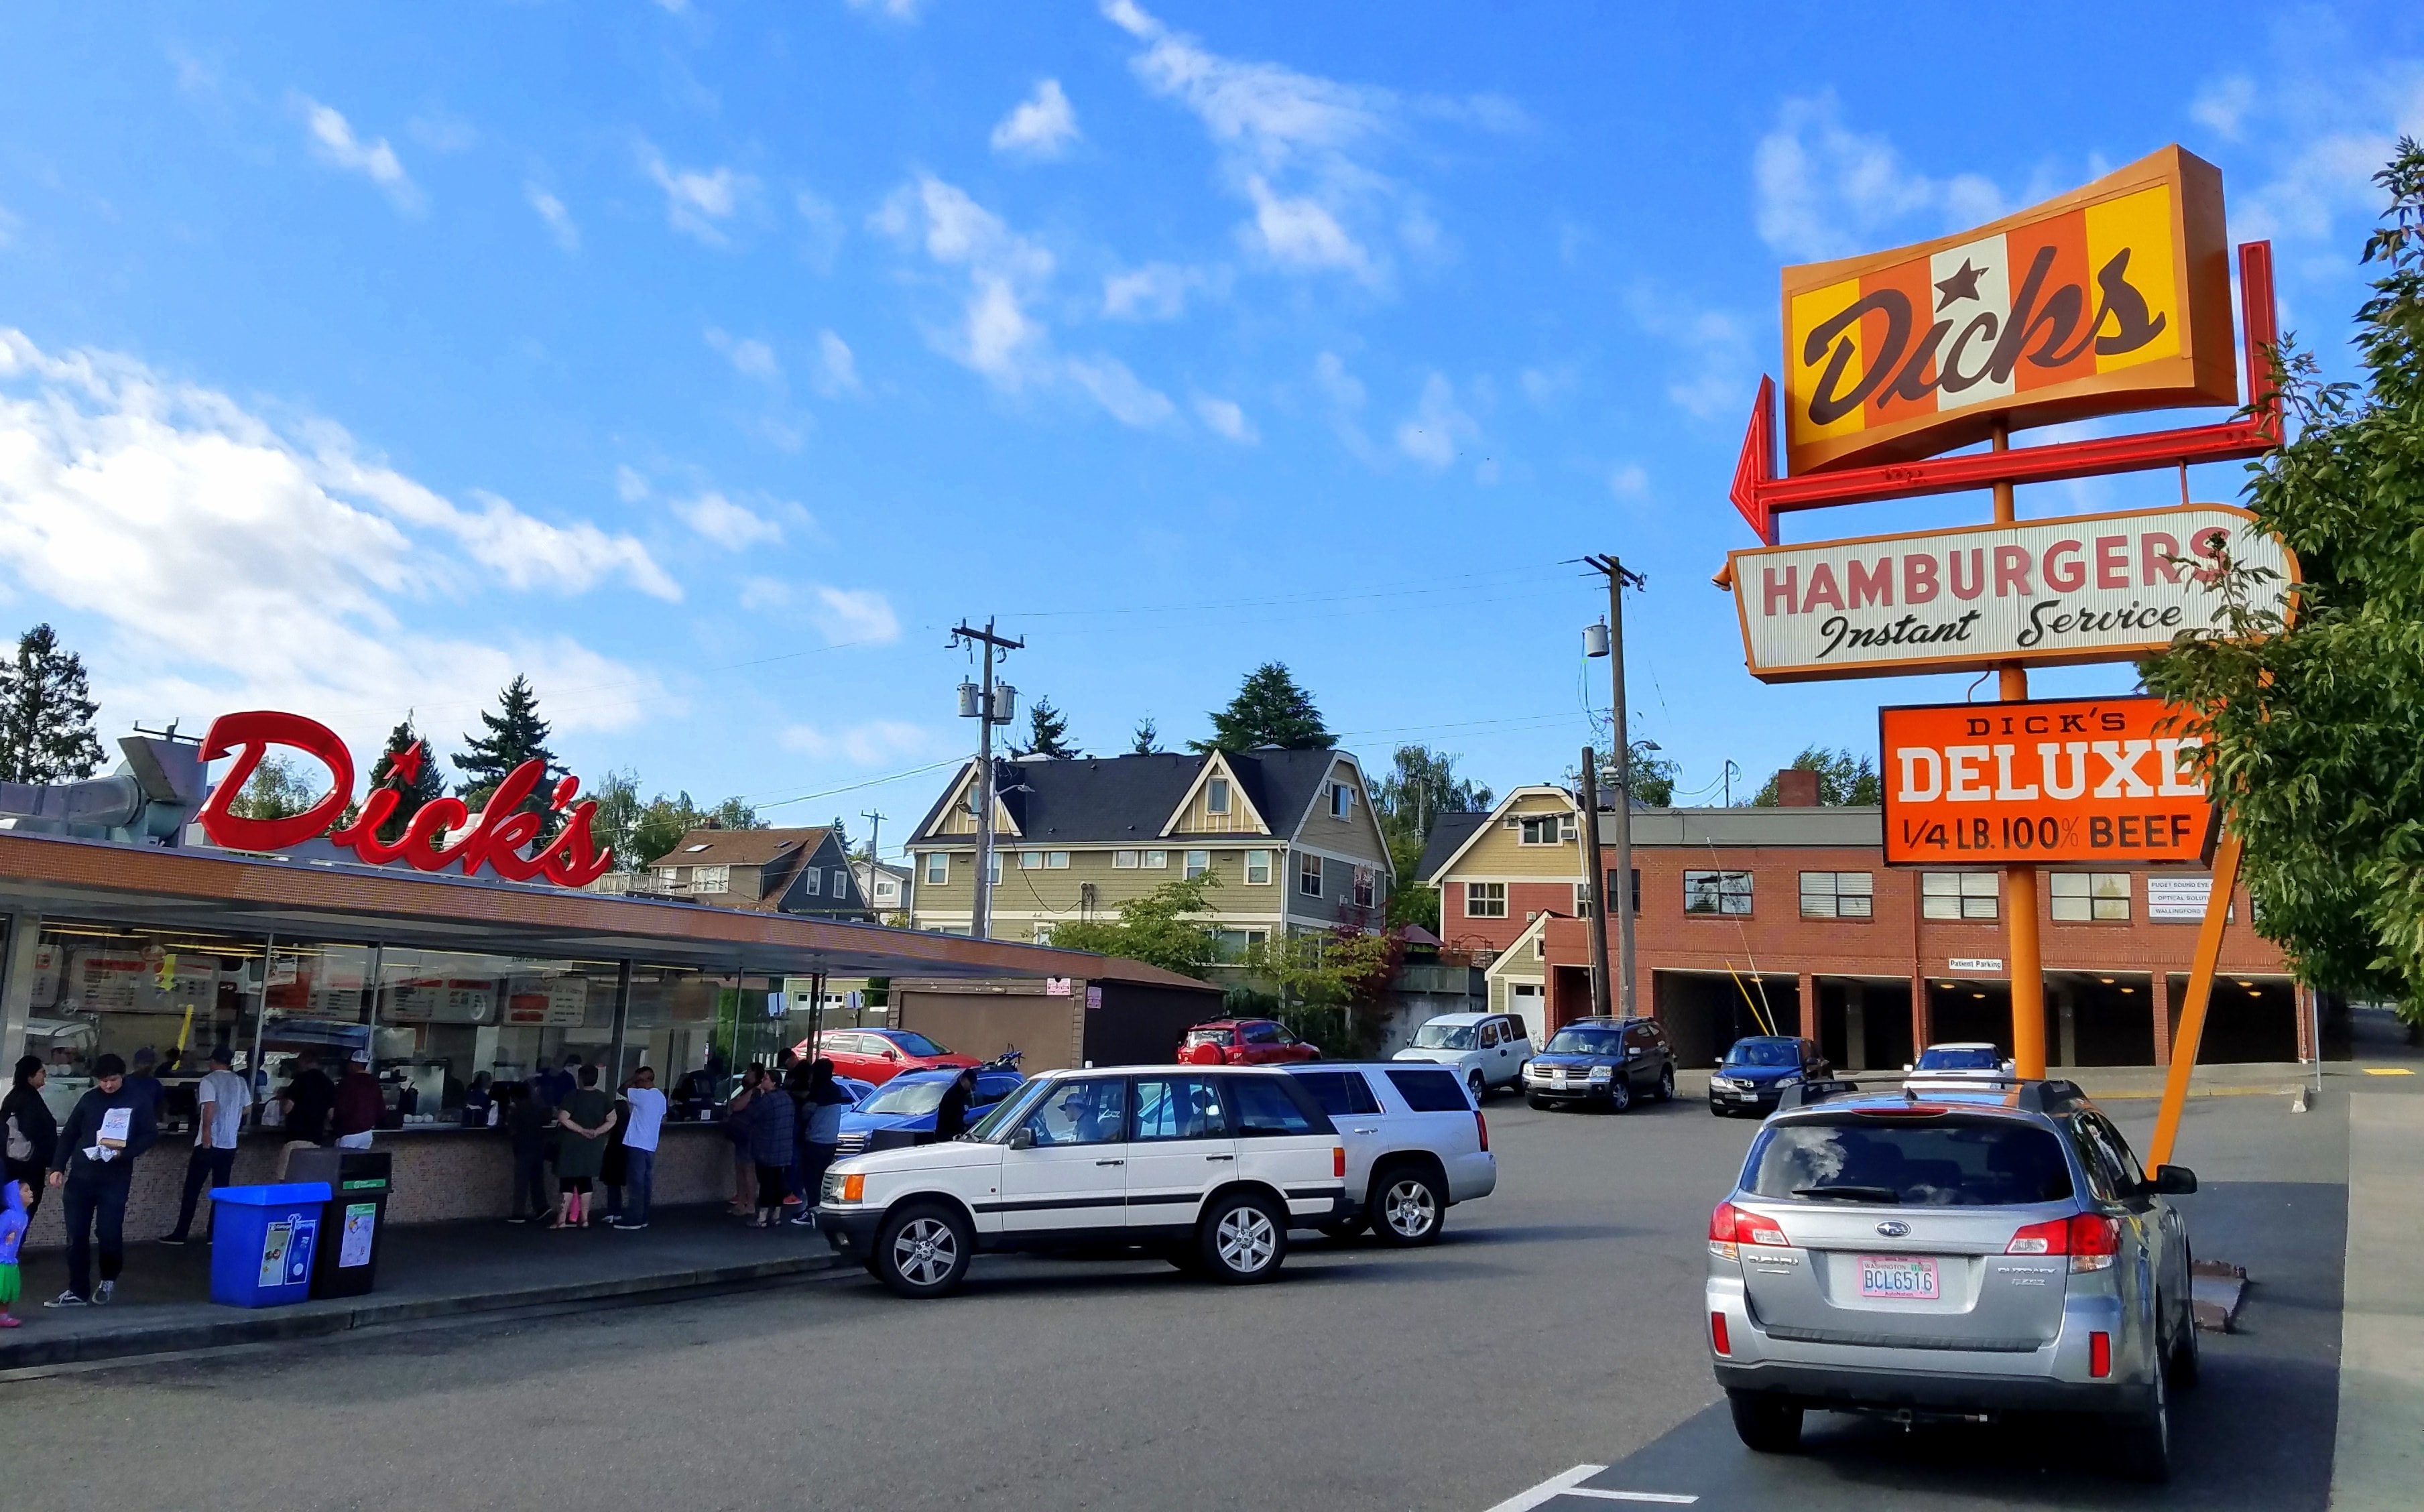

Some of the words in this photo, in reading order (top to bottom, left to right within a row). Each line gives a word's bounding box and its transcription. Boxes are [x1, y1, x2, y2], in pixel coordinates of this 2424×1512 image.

[1762, 527, 2232, 616] HAMBURGERS
[1815, 609, 1982, 658] Instant
[2016, 599, 2183, 647] Service
[1966, 707, 2126, 736] DICK'S
[197, 710, 613, 887] Dick's
[1897, 737, 2205, 802] DELUXE
[1904, 818, 1949, 849] 1/4
[2089, 814, 2191, 848] BEEF
[1865, 1269, 1933, 1291] BCL6516
